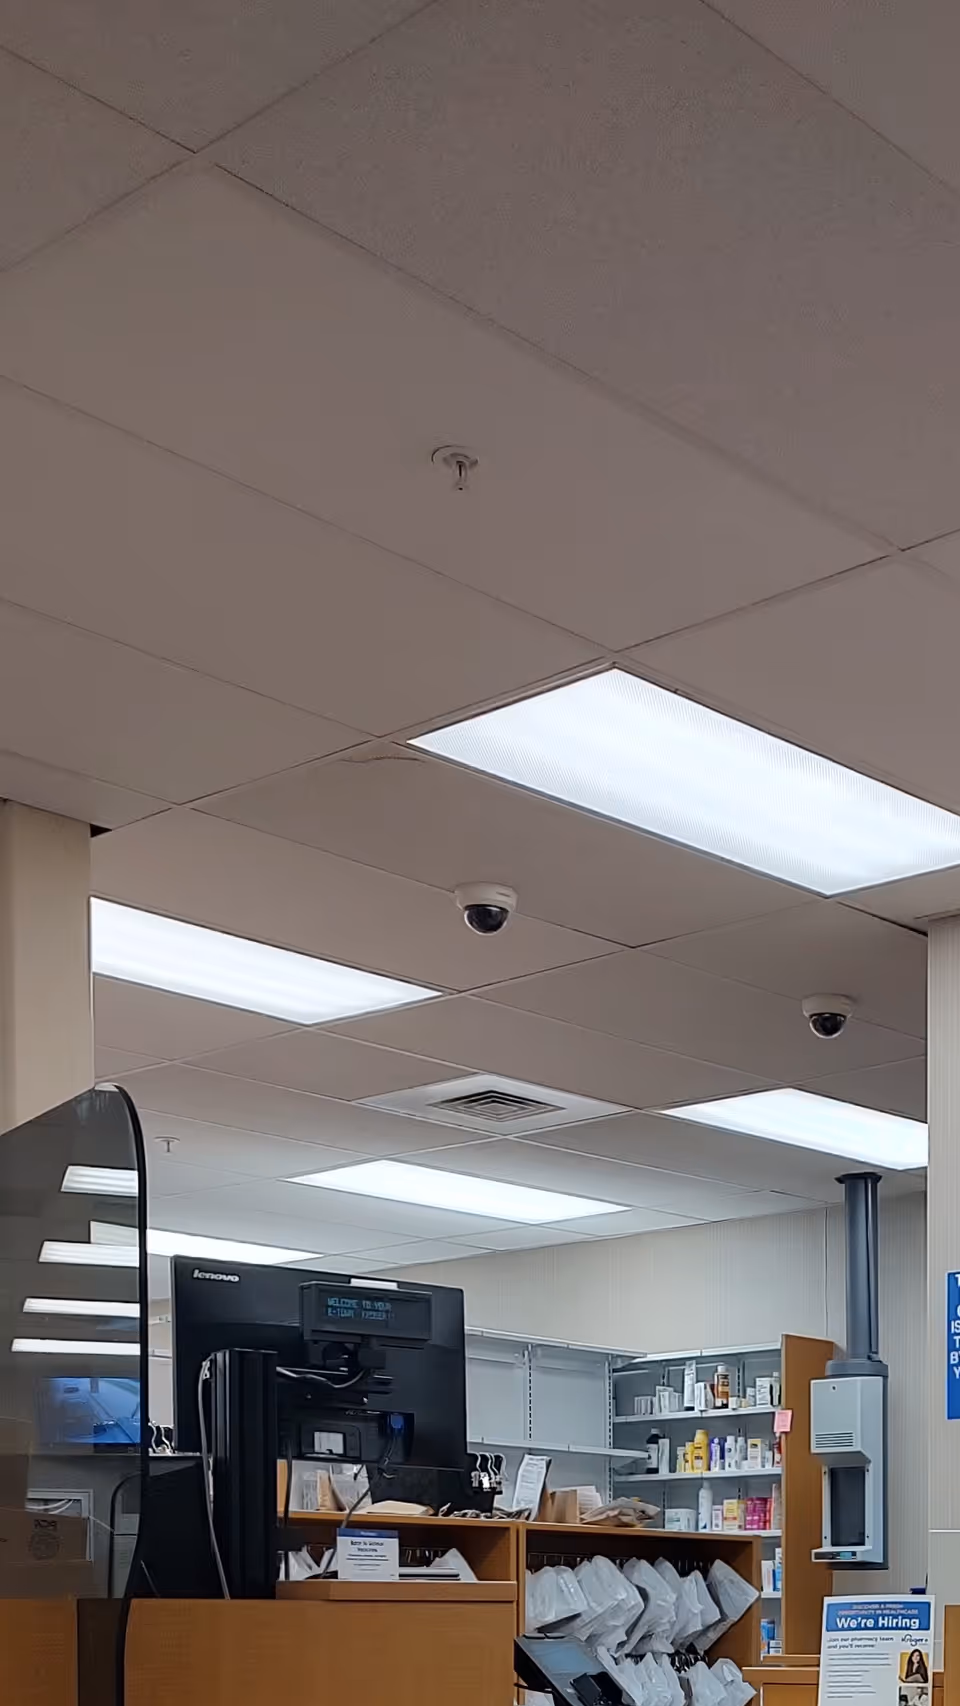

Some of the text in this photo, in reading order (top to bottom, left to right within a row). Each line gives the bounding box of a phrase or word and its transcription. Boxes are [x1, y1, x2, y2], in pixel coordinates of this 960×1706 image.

[193, 1269, 239, 1282] lenovo
[837, 1616, 919, 1629] We're Hiring
[902, 1634, 924, 1647] Kroger
